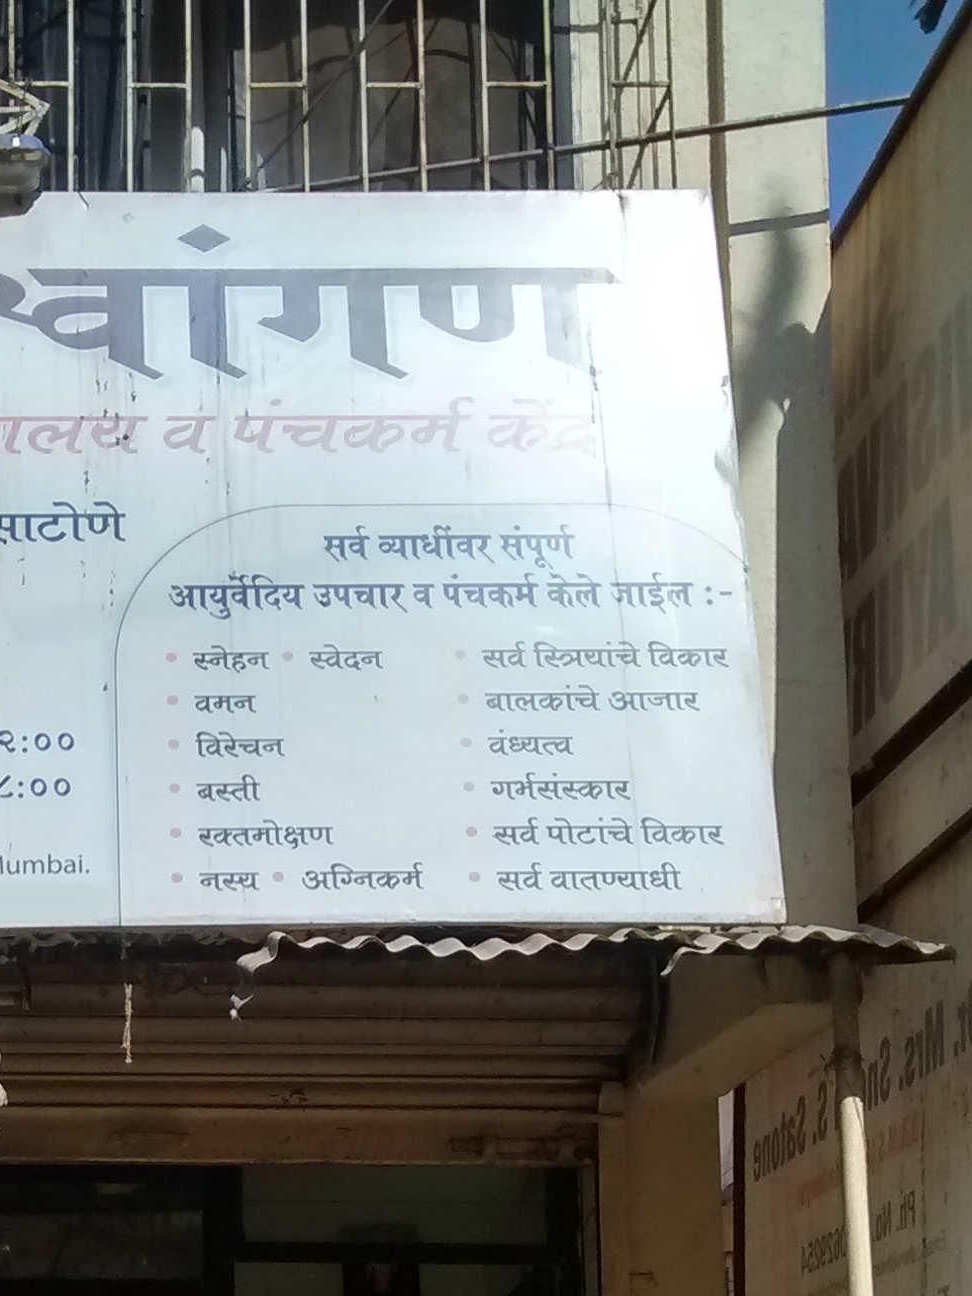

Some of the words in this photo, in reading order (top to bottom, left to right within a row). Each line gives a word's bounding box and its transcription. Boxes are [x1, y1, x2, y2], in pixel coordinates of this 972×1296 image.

[163, 415, 217, 453] व
[234, 396, 475, 453] पंचकर्म
[324, 525, 369, 562] सर्व
[378, 525, 495, 563] व्याधींवर
[500, 524, 574, 569] संपूर्ण
[313, 583, 408, 613] उपचार
[413, 583, 435, 609] व
[443, 572, 538, 608] पंचकर्म
[547, 572, 601, 608] केले
[610, 572, 693, 614] जाईल
[193, 645, 270, 670] स्नेहन
[309, 645, 382, 669] स्वेदन
[483, 641, 526, 669] सर्व
[648, 641, 729, 669] विकार
[194, 694, 257, 714] वमन
[485, 687, 599, 713] बालकांचे
[608, 690, 700, 713] आजार
[195, 732, 284, 758] विरेचन
[488, 731, 573, 756] वंध्यत्व
[197, 775, 259, 801] बस्ती
[491, 772, 631, 800] गर्भसंस्कार
[197, 819, 333, 846] रक्तमोक्षण
[547, 817, 633, 845] पोटांचे
[640, 817, 724, 845] विकार
[200, 870, 259, 892] नस्य
[302, 865, 425, 892] अग्निकर्म
[497, 862, 542, 890] सर्व
